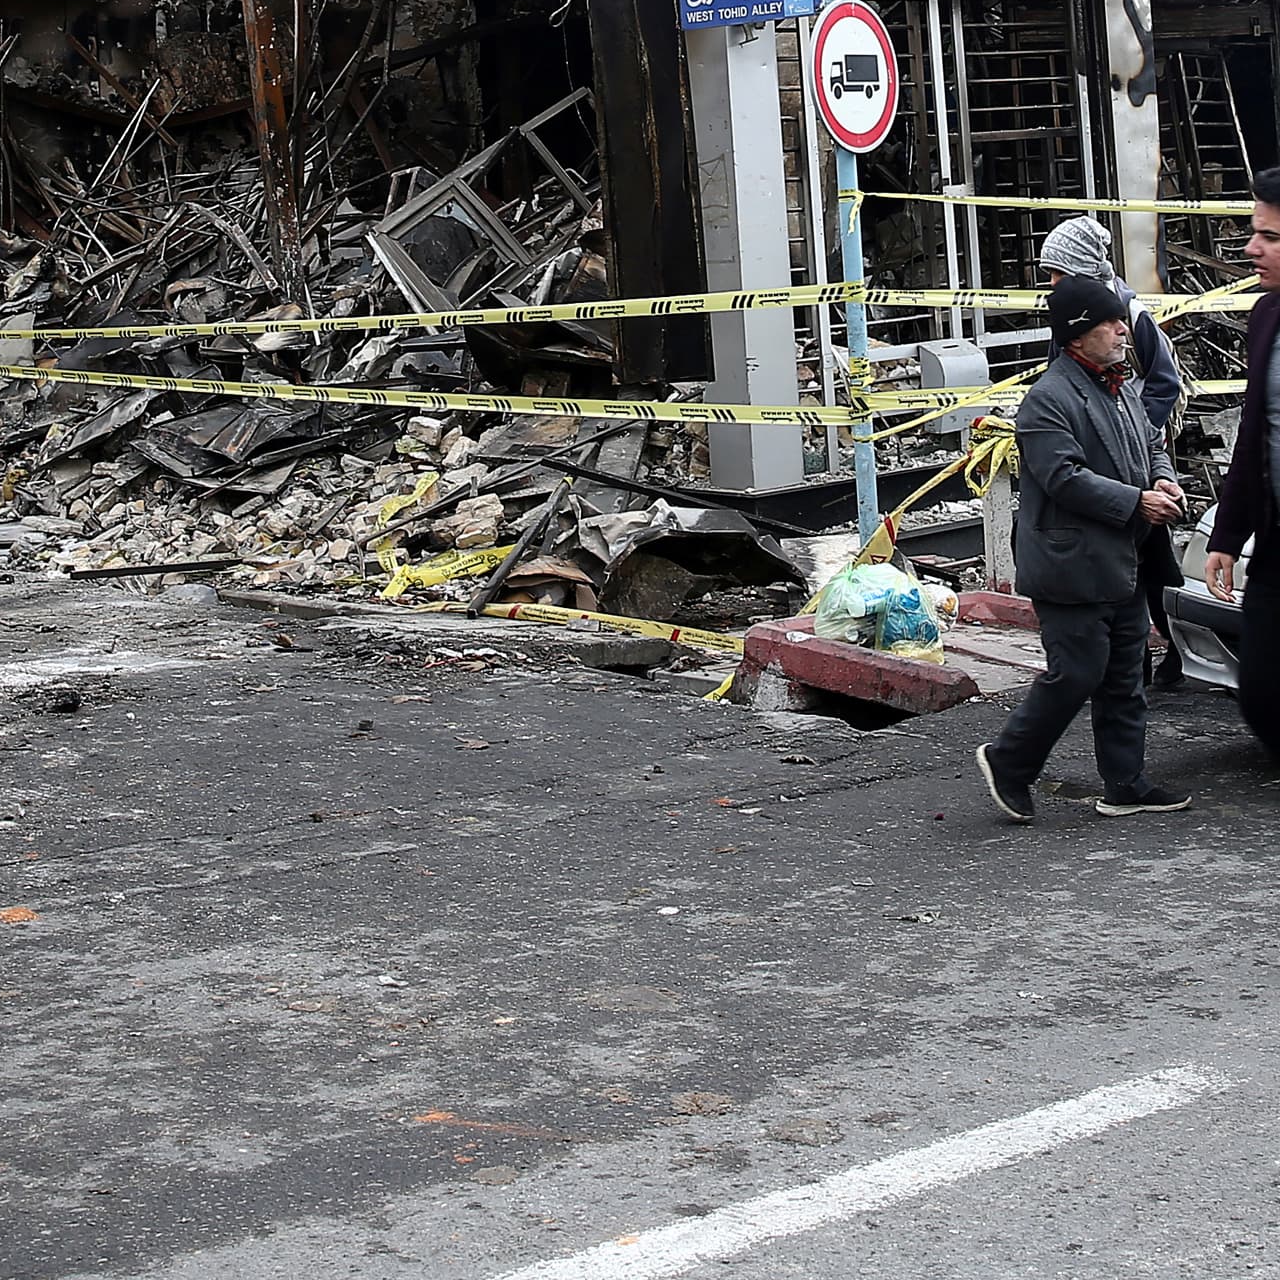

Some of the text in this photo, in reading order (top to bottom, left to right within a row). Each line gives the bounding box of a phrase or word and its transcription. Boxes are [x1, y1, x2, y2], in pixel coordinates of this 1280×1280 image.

[686, 1, 783, 22] WEST TOHID ALLEY
